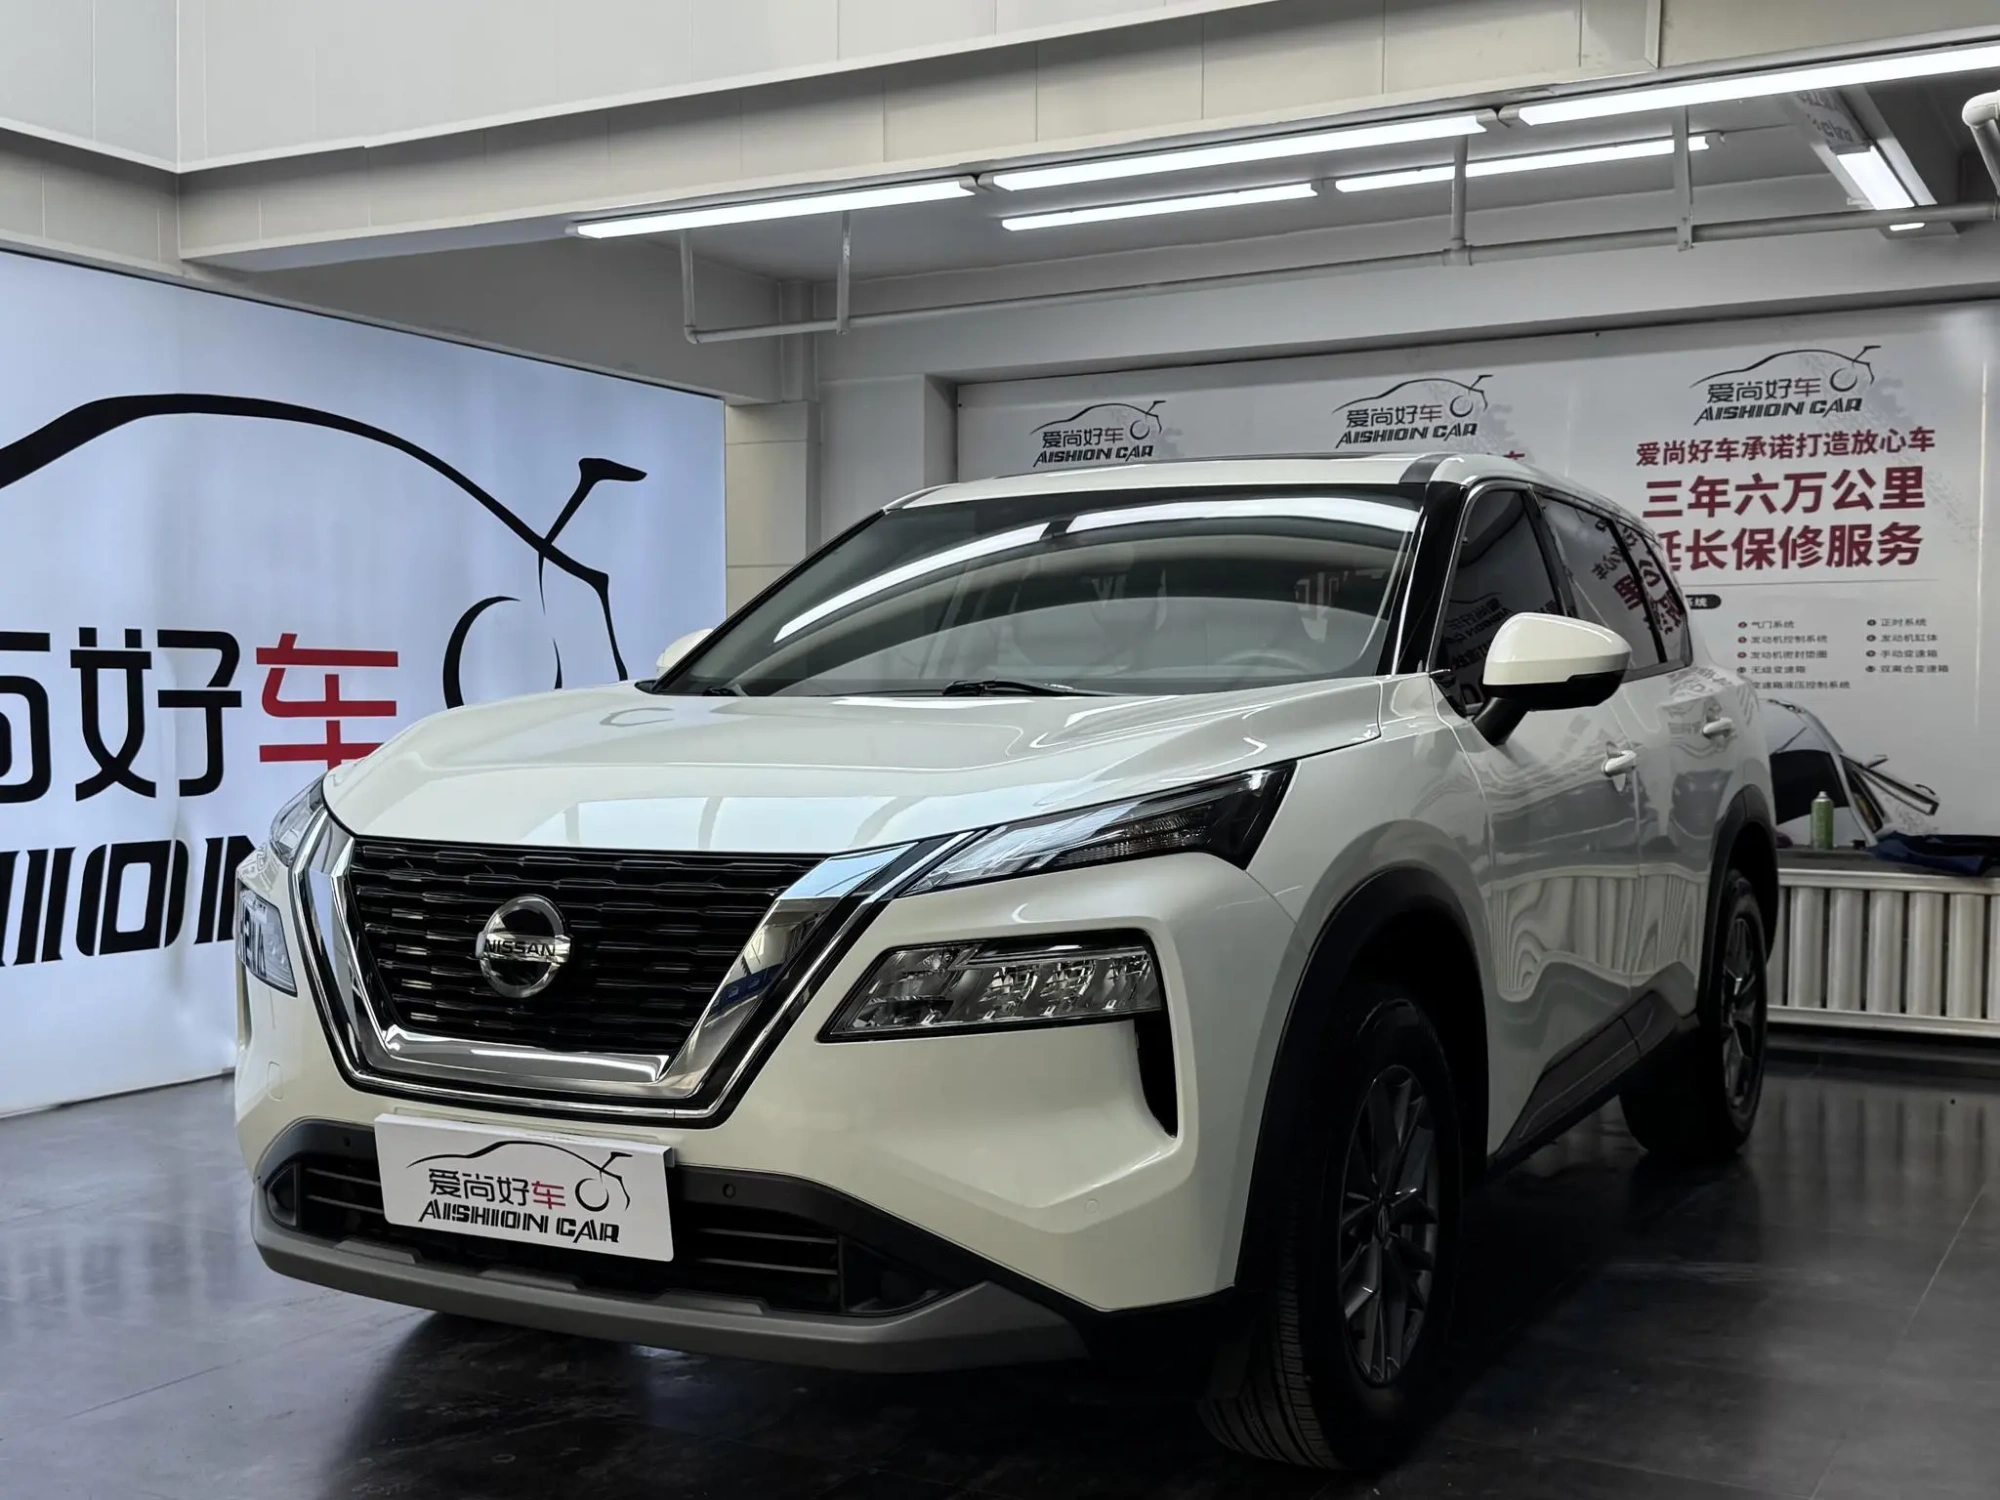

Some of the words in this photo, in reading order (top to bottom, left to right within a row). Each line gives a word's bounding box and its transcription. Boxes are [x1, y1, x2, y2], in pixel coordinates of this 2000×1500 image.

[1707, 377, 1821, 404] 爱尚好车
[1346, 403, 1442, 428] 爱尚好车
[1693, 401, 1805, 426] AISHION
[1809, 398, 1863, 418] CAR
[1042, 427, 1124, 448] 爱尚好车
[1335, 426, 1429, 449] AISHION
[1433, 422, 1478, 441] CAR
[1636, 426, 1935, 466] 爱尚好车承诺打造放心车
[1033, 447, 1113, 468] AISHION
[1115, 444, 1154, 462] CAR
[1642, 465, 1926, 518] 三年六万公里
[1751, 620, 1795, 629] 气门系统
[1880, 618, 1928, 627] 正时系统
[1751, 635, 1828, 644] 发动机控制系统
[1880, 634, 1938, 643] 发动机缸体
[1880, 649, 1938, 659] 手动变速箱
[1880, 664, 1949, 673] 双离合变速箱
[486, 940, 556, 957] NISSAN
[428, 1168, 566, 1210] 爱尚好车
[418, 1199, 549, 1234] AISHION
[556, 1217, 620, 1243] CAR
